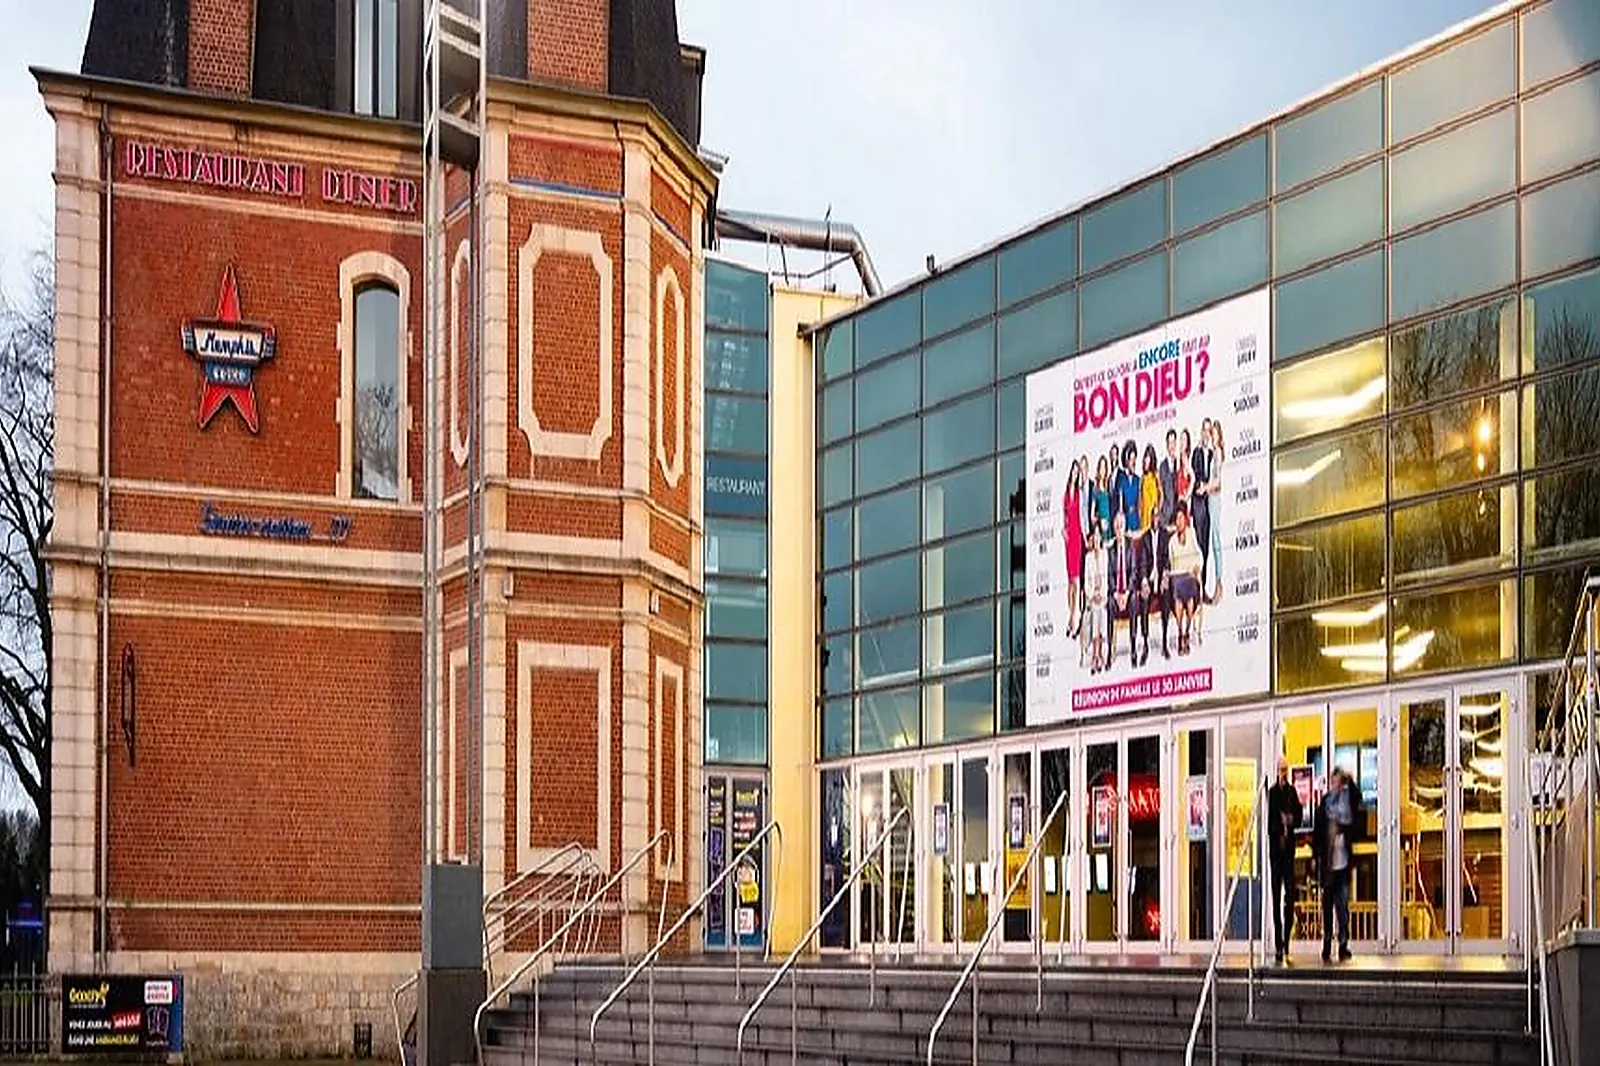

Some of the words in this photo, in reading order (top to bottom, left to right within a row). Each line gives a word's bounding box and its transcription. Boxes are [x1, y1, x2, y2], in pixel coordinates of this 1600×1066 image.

[126, 142, 305, 197] RESTAURANT
[322, 167, 417, 213] DINER
[1138, 339, 1181, 370] ENCORE
[1073, 378, 1129, 434] BON
